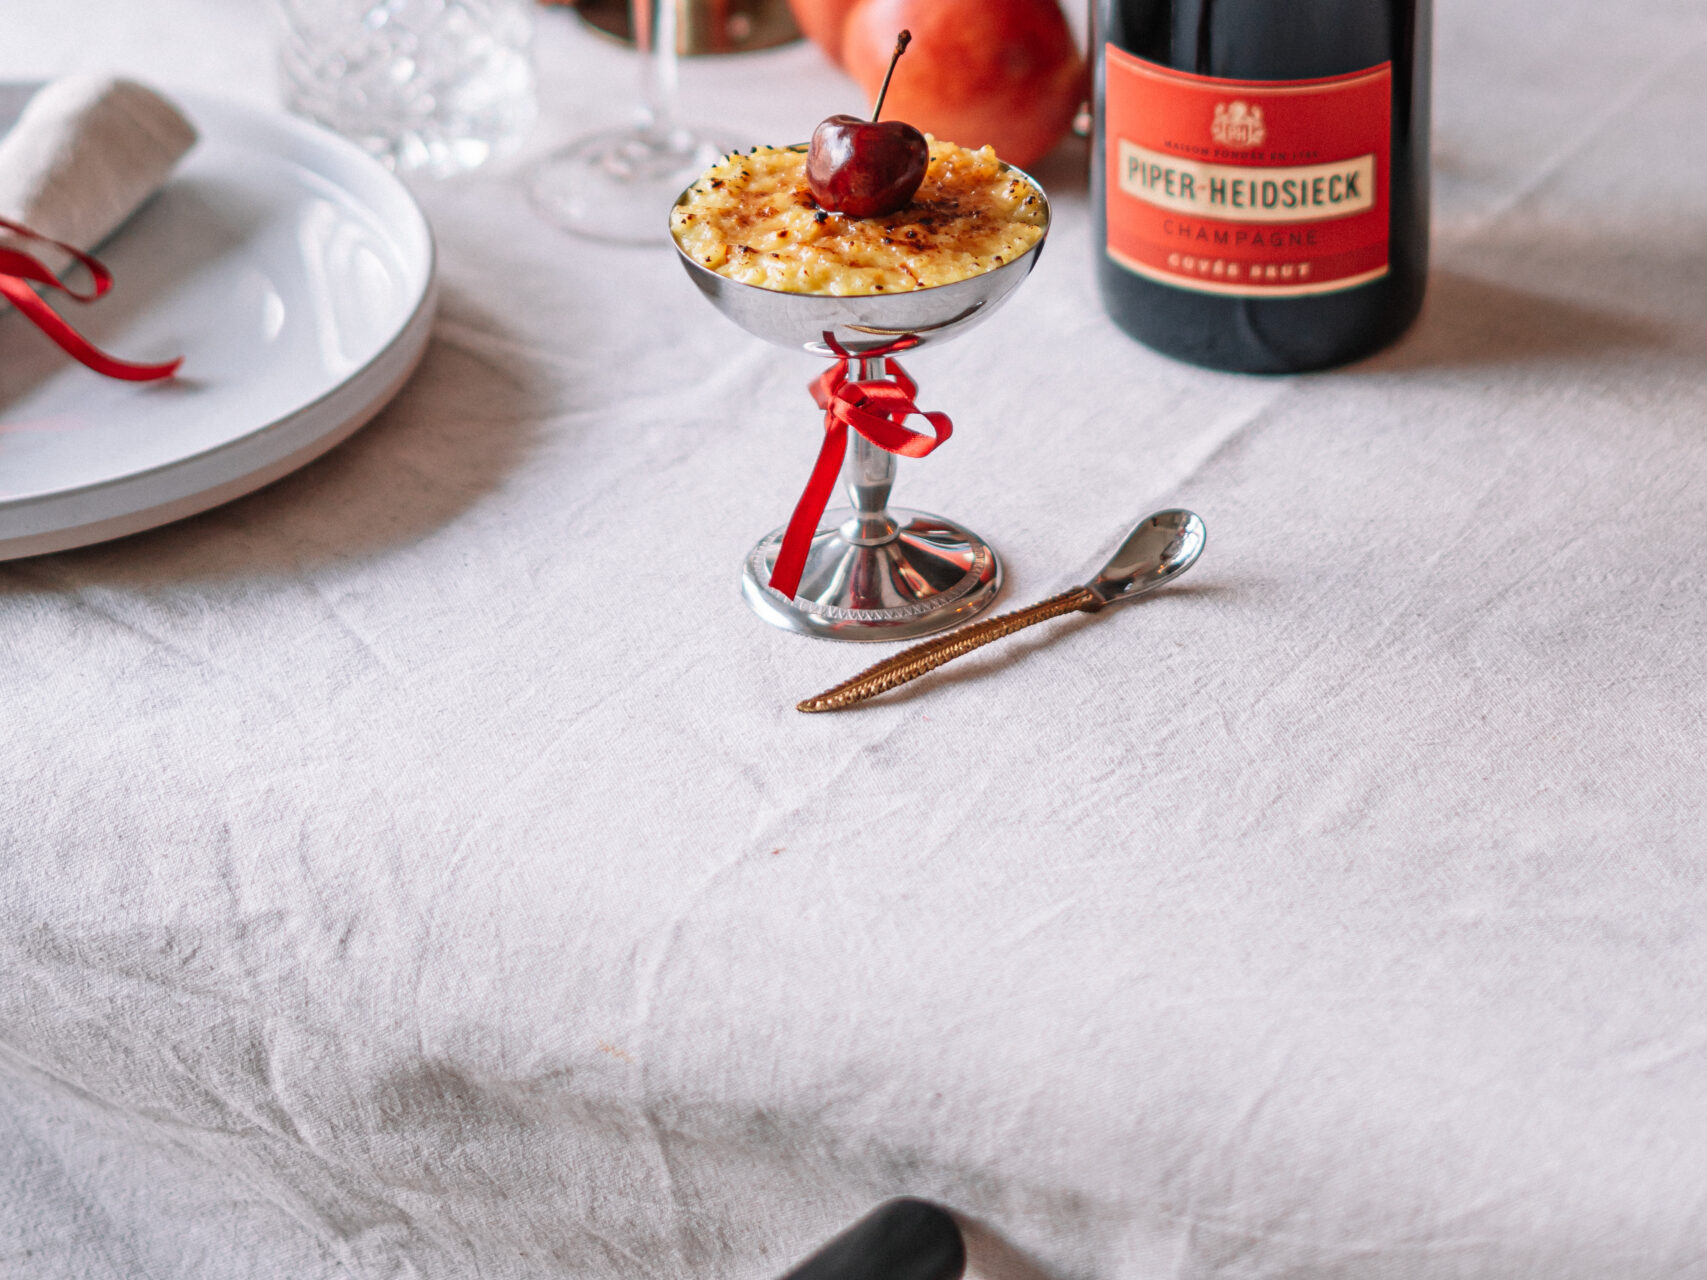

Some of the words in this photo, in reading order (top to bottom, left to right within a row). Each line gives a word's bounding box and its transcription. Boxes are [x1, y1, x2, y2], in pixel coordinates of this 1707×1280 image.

[1165, 140, 1209, 156] MAISON
[1270, 151, 1287, 161] EN
[1163, 219, 1318, 247] CHAMPAGNE
[1250, 262, 1311, 279] BRUT
